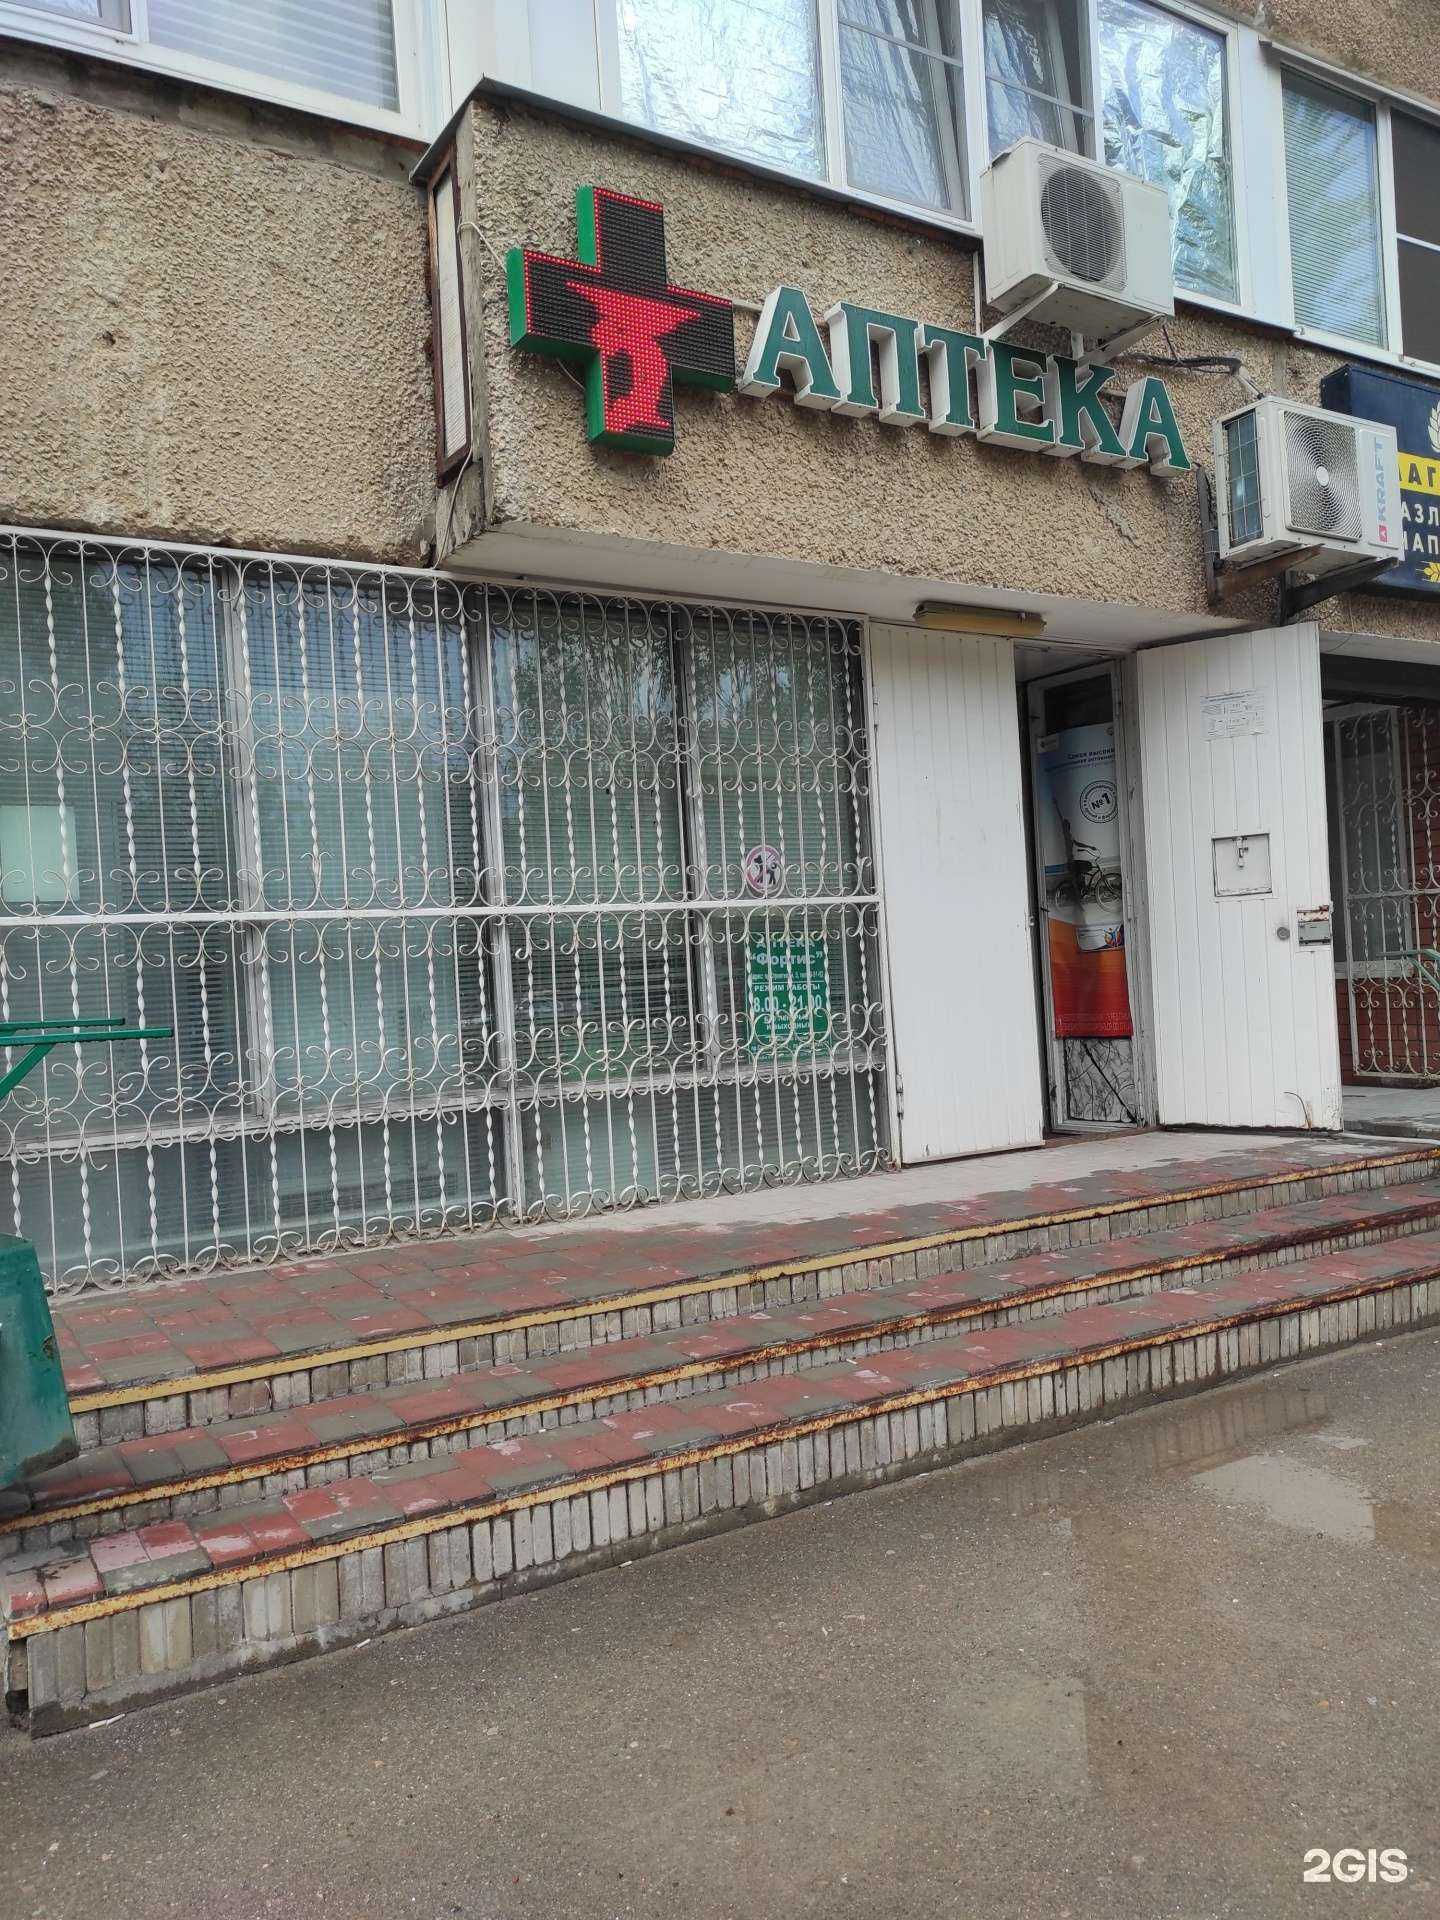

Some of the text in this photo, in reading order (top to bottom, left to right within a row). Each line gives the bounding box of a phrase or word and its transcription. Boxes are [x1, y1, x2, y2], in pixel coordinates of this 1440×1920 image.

[743, 286, 1191, 473] АПТЕКА
[1374, 436, 1386, 521] KRAFT
[1398, 462, 1437, 488] АГ
